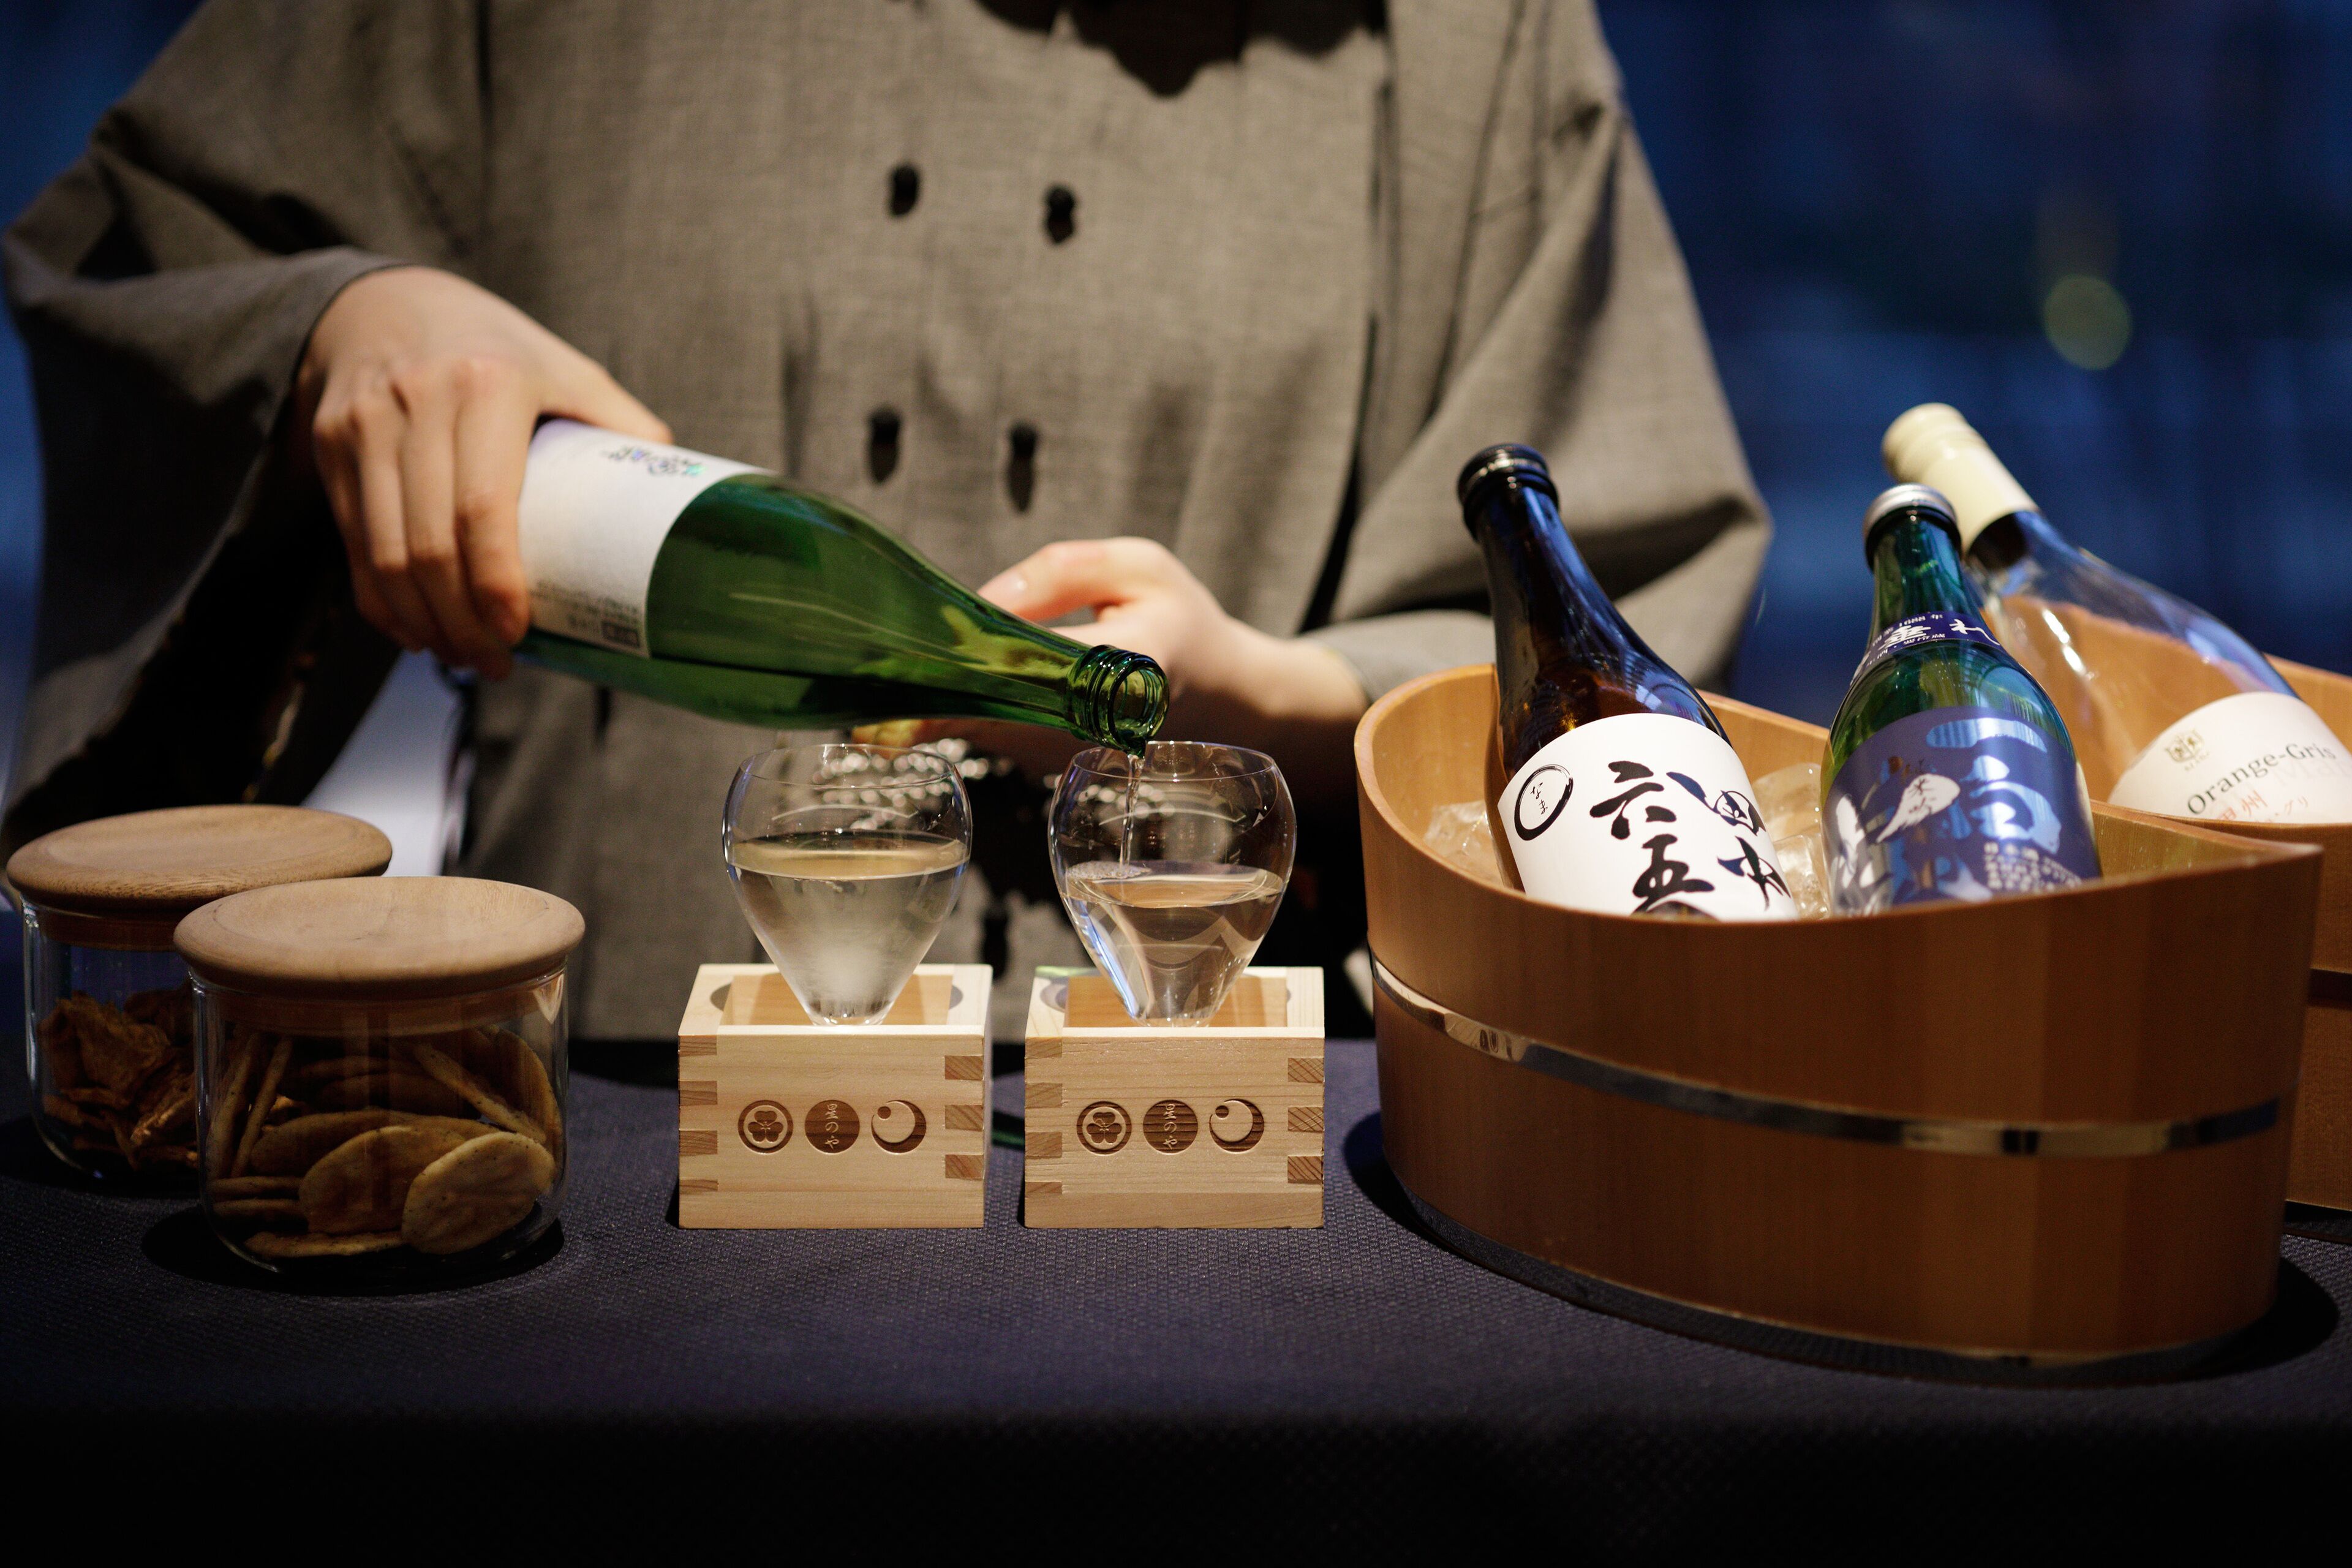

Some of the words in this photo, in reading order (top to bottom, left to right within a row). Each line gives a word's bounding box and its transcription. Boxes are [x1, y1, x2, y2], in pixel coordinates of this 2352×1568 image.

[2187, 742, 2337, 815] Orange-Gris
[824, 1103, 840, 1150] 星のや
[1163, 1103, 1178, 1150] 星のや
